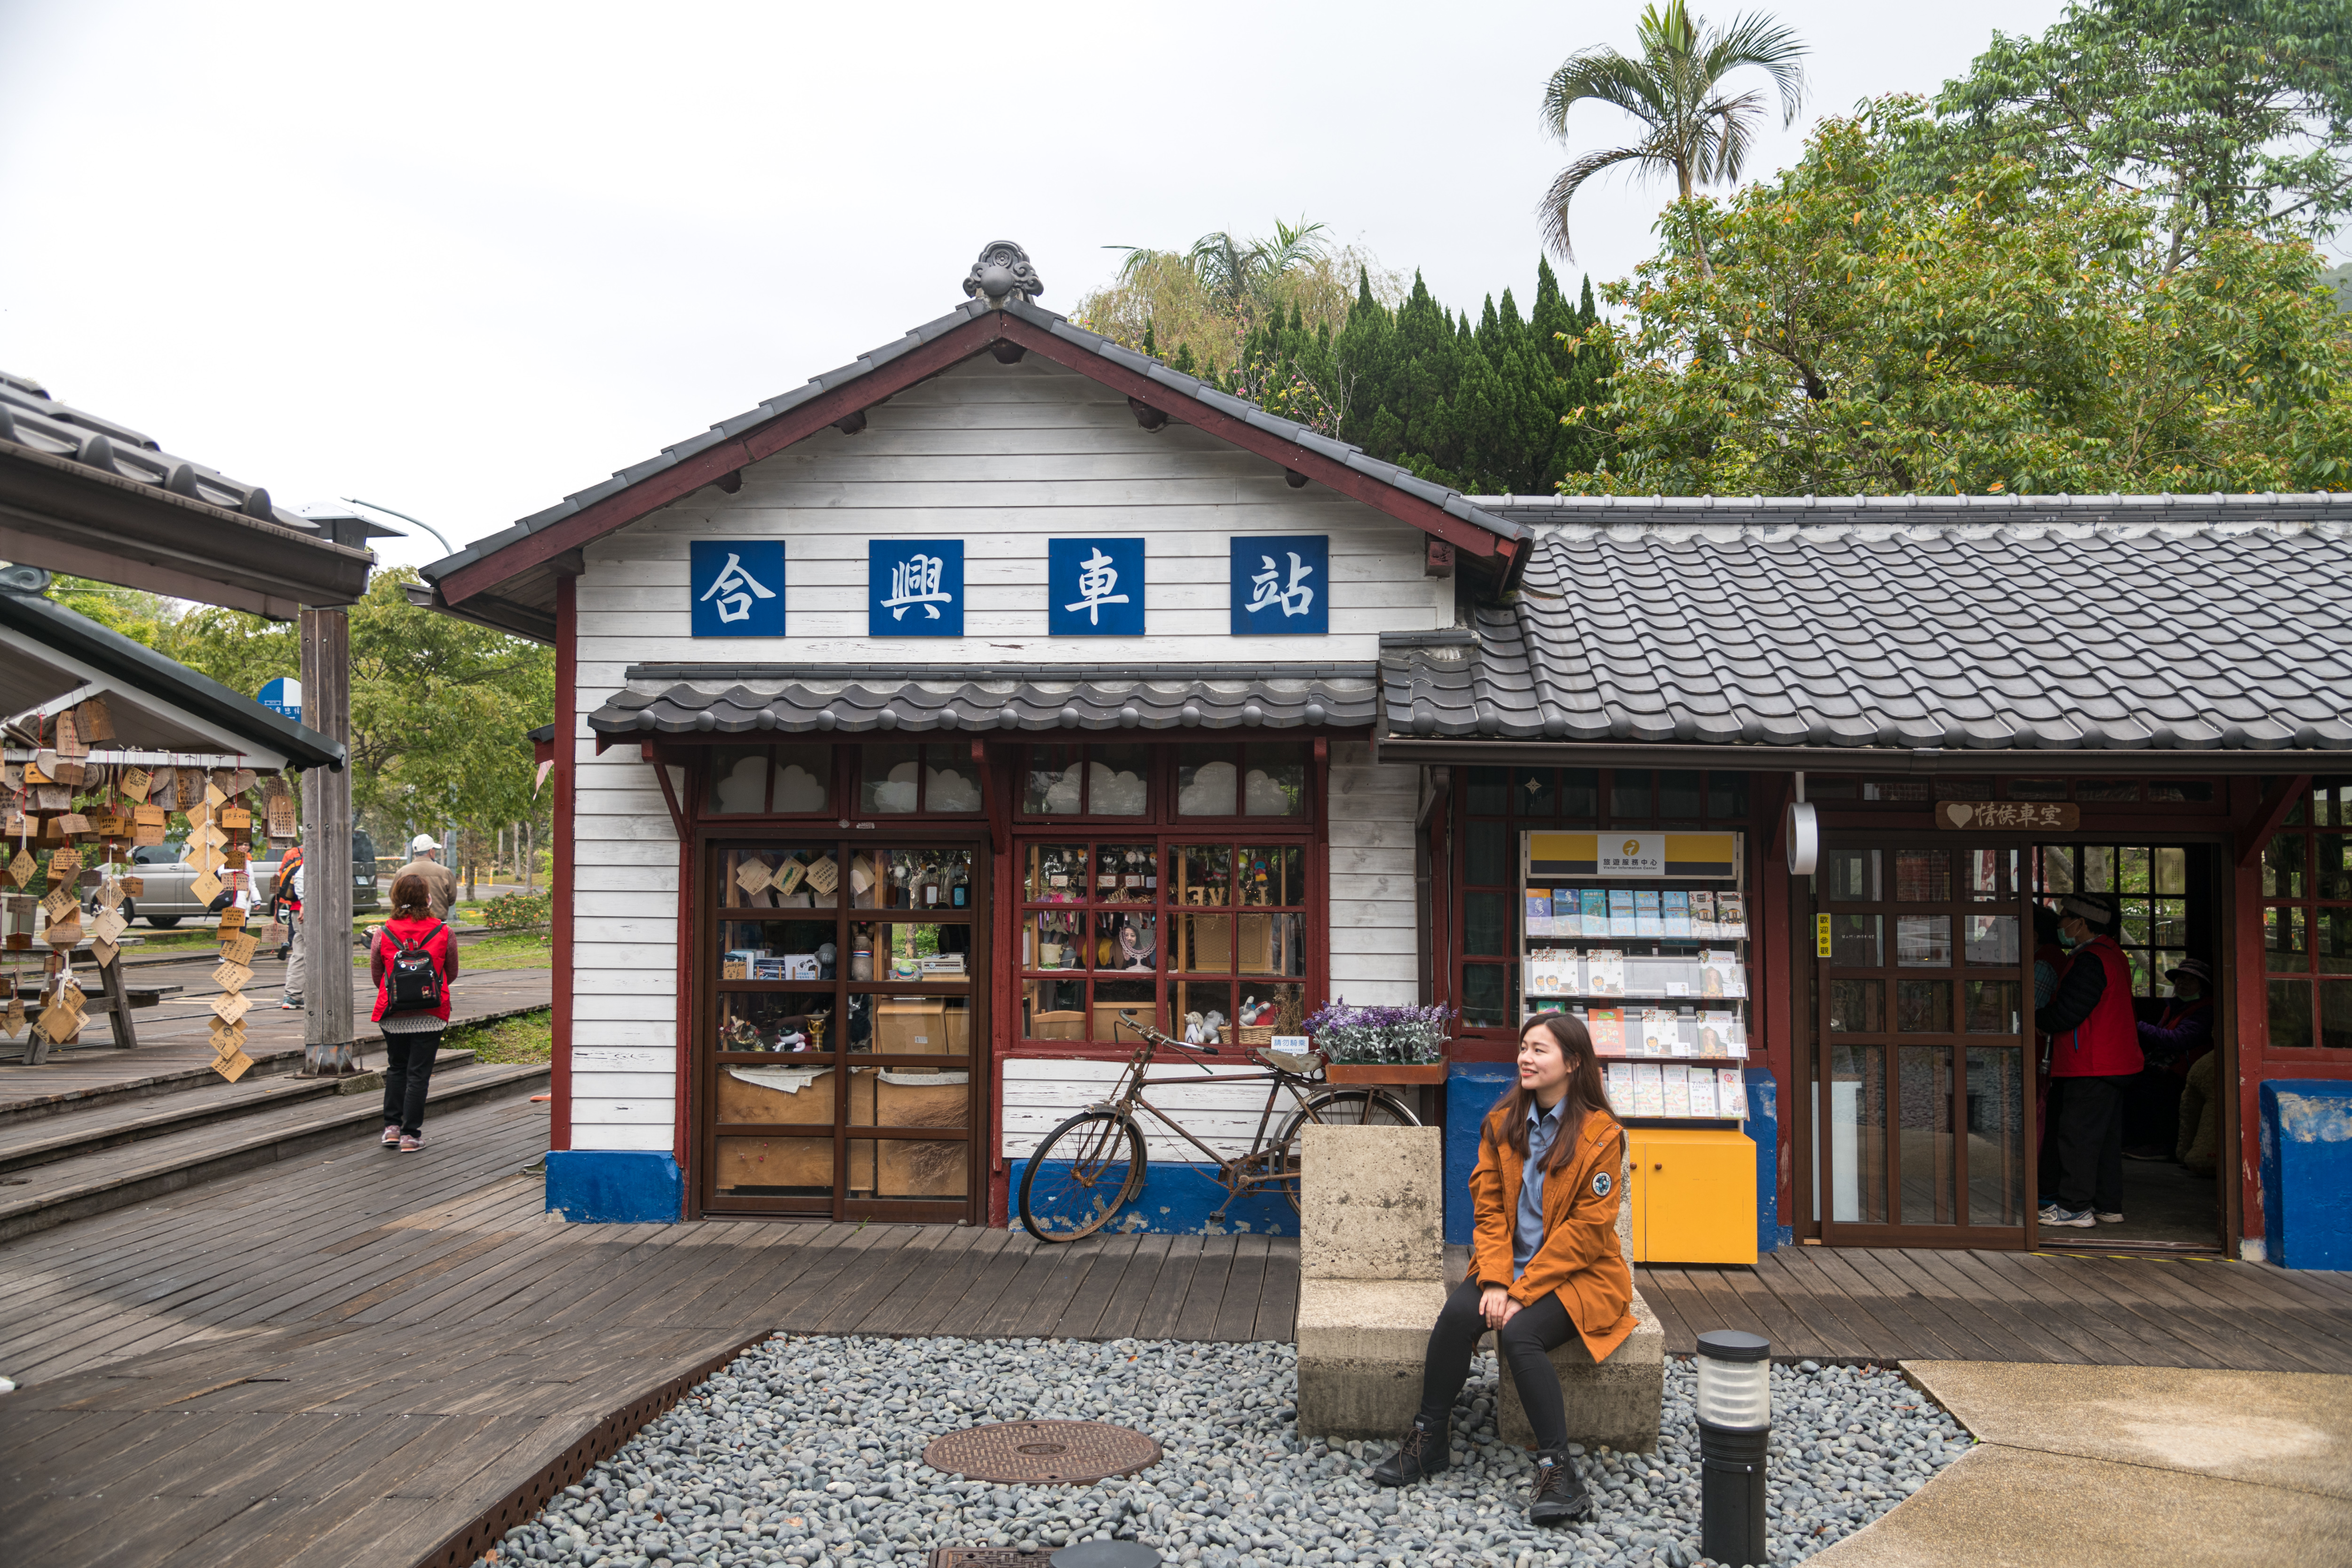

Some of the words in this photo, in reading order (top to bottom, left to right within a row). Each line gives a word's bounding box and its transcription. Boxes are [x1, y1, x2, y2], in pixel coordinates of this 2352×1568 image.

[700, 547, 1314, 625] 合興車站
[1975, 802, 2061, 828] 情候車室
[1820, 916, 1829, 955] 歡迎參觀
